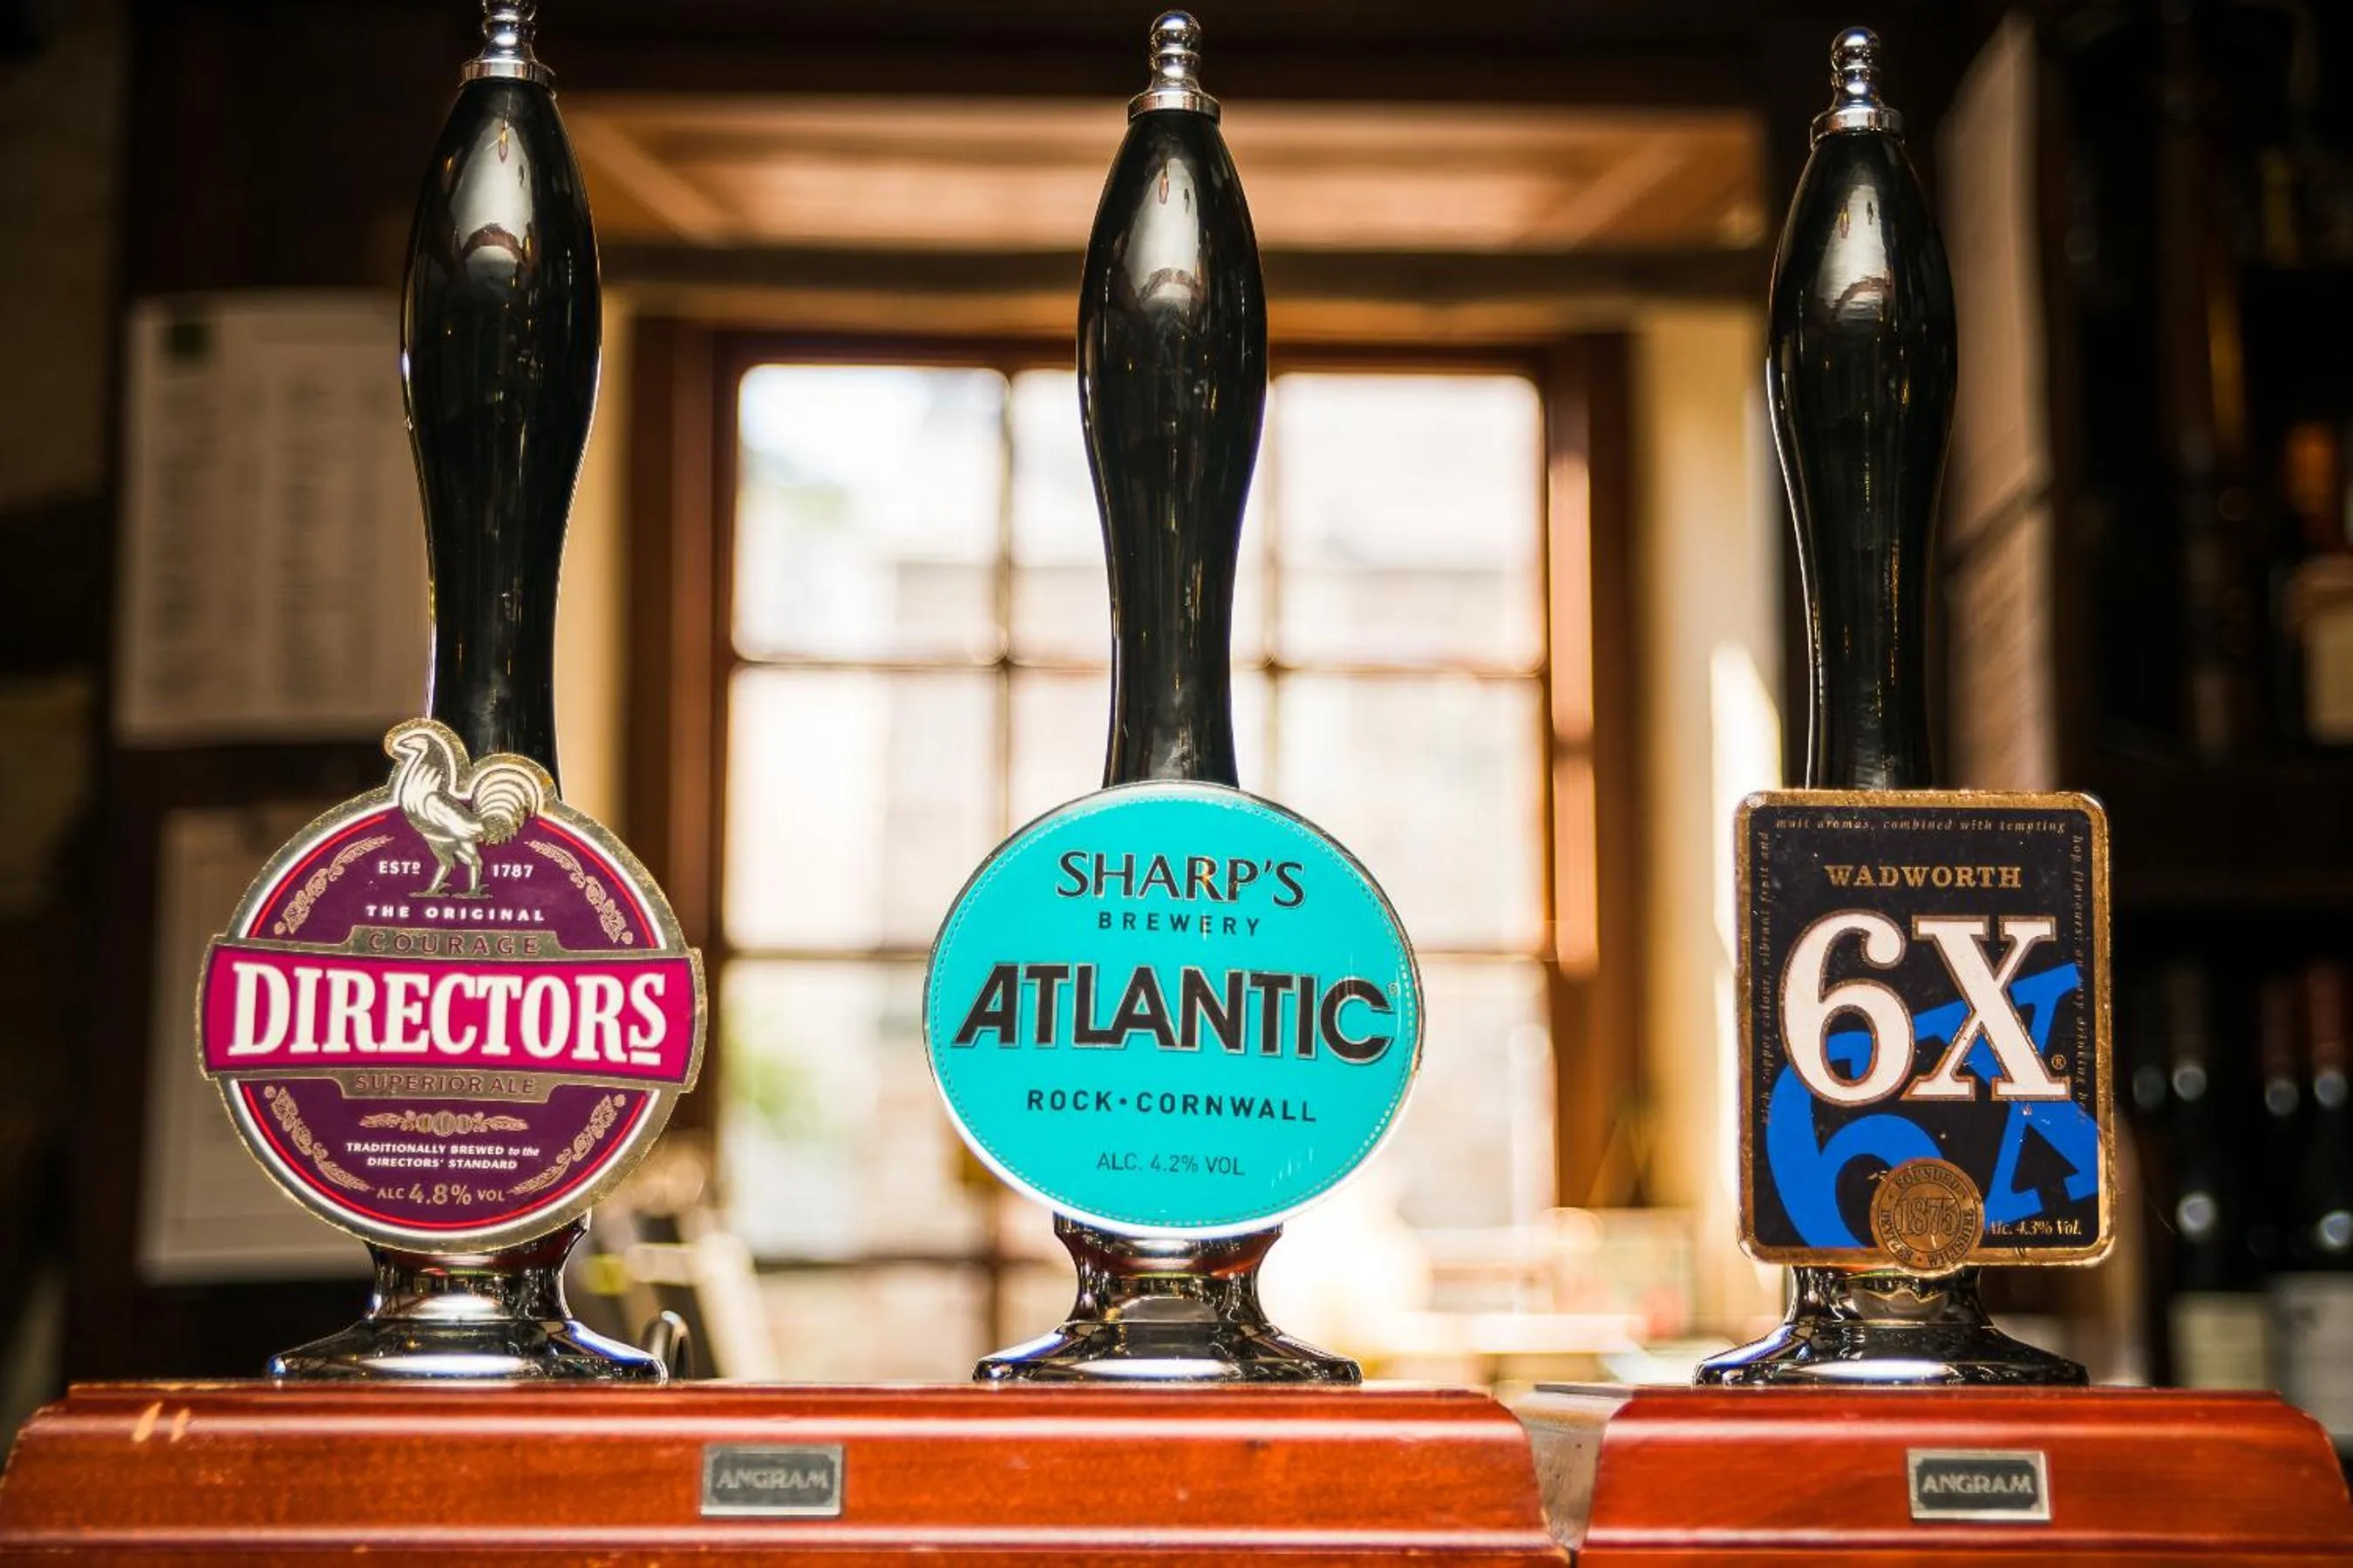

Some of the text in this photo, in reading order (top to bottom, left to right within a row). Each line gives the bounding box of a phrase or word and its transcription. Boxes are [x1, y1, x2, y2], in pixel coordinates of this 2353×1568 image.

[1817, 818, 1874, 832] aromas,
[1883, 818, 1954, 830] combined
[1960, 819, 1992, 830] with
[2000, 820, 2066, 834] tempting
[1758, 832, 1770, 859] and
[2071, 835, 2084, 862] hop
[493, 864, 534, 879] 1787
[1055, 851, 1305, 908] SHARP'S
[1824, 864, 2023, 888] WADWORTH
[366, 905, 545, 921] THE ORIGINAL
[1098, 912, 1261, 937] BREWERY
[368, 932, 540, 956] COURAGE
[1759, 910, 1771, 966] vibrant
[228, 961, 667, 1065] DIRECTORS
[952, 960, 1396, 1066] ATLANTIC
[355, 1074, 537, 1095] SUPERIOR ALE
[345, 1143, 541, 1157] TRADITIONALLY BREWED to the
[448, 1158, 518, 1170] STANDARD
[1097, 1154, 1246, 1177] ALC. 4.2% VOL
[377, 1182, 506, 1206] ALC 4.8% VOL
[1894, 1196, 1960, 1237] 1875
[2016, 1221, 2053, 1235] 4.3%
[2057, 1220, 2083, 1235] Vol.
[716, 1468, 828, 1490] ANGRAM
[1921, 1473, 2035, 1494] ANGRAM
